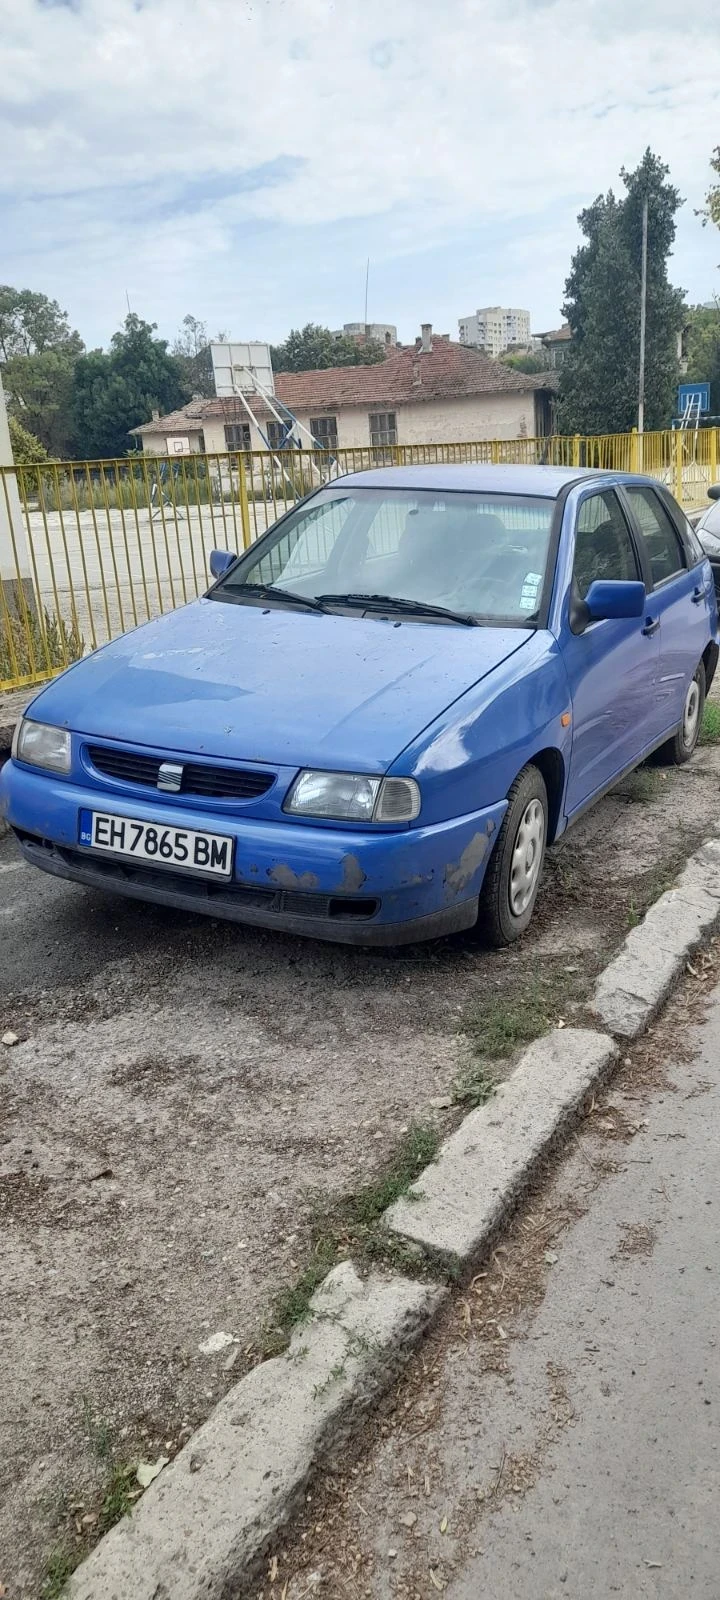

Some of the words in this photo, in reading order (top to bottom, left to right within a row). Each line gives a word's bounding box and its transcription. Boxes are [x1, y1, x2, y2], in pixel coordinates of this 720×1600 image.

[95, 817, 125, 849] EH
[130, 824, 188, 861] 7865
[194, 837, 228, 870] BM
